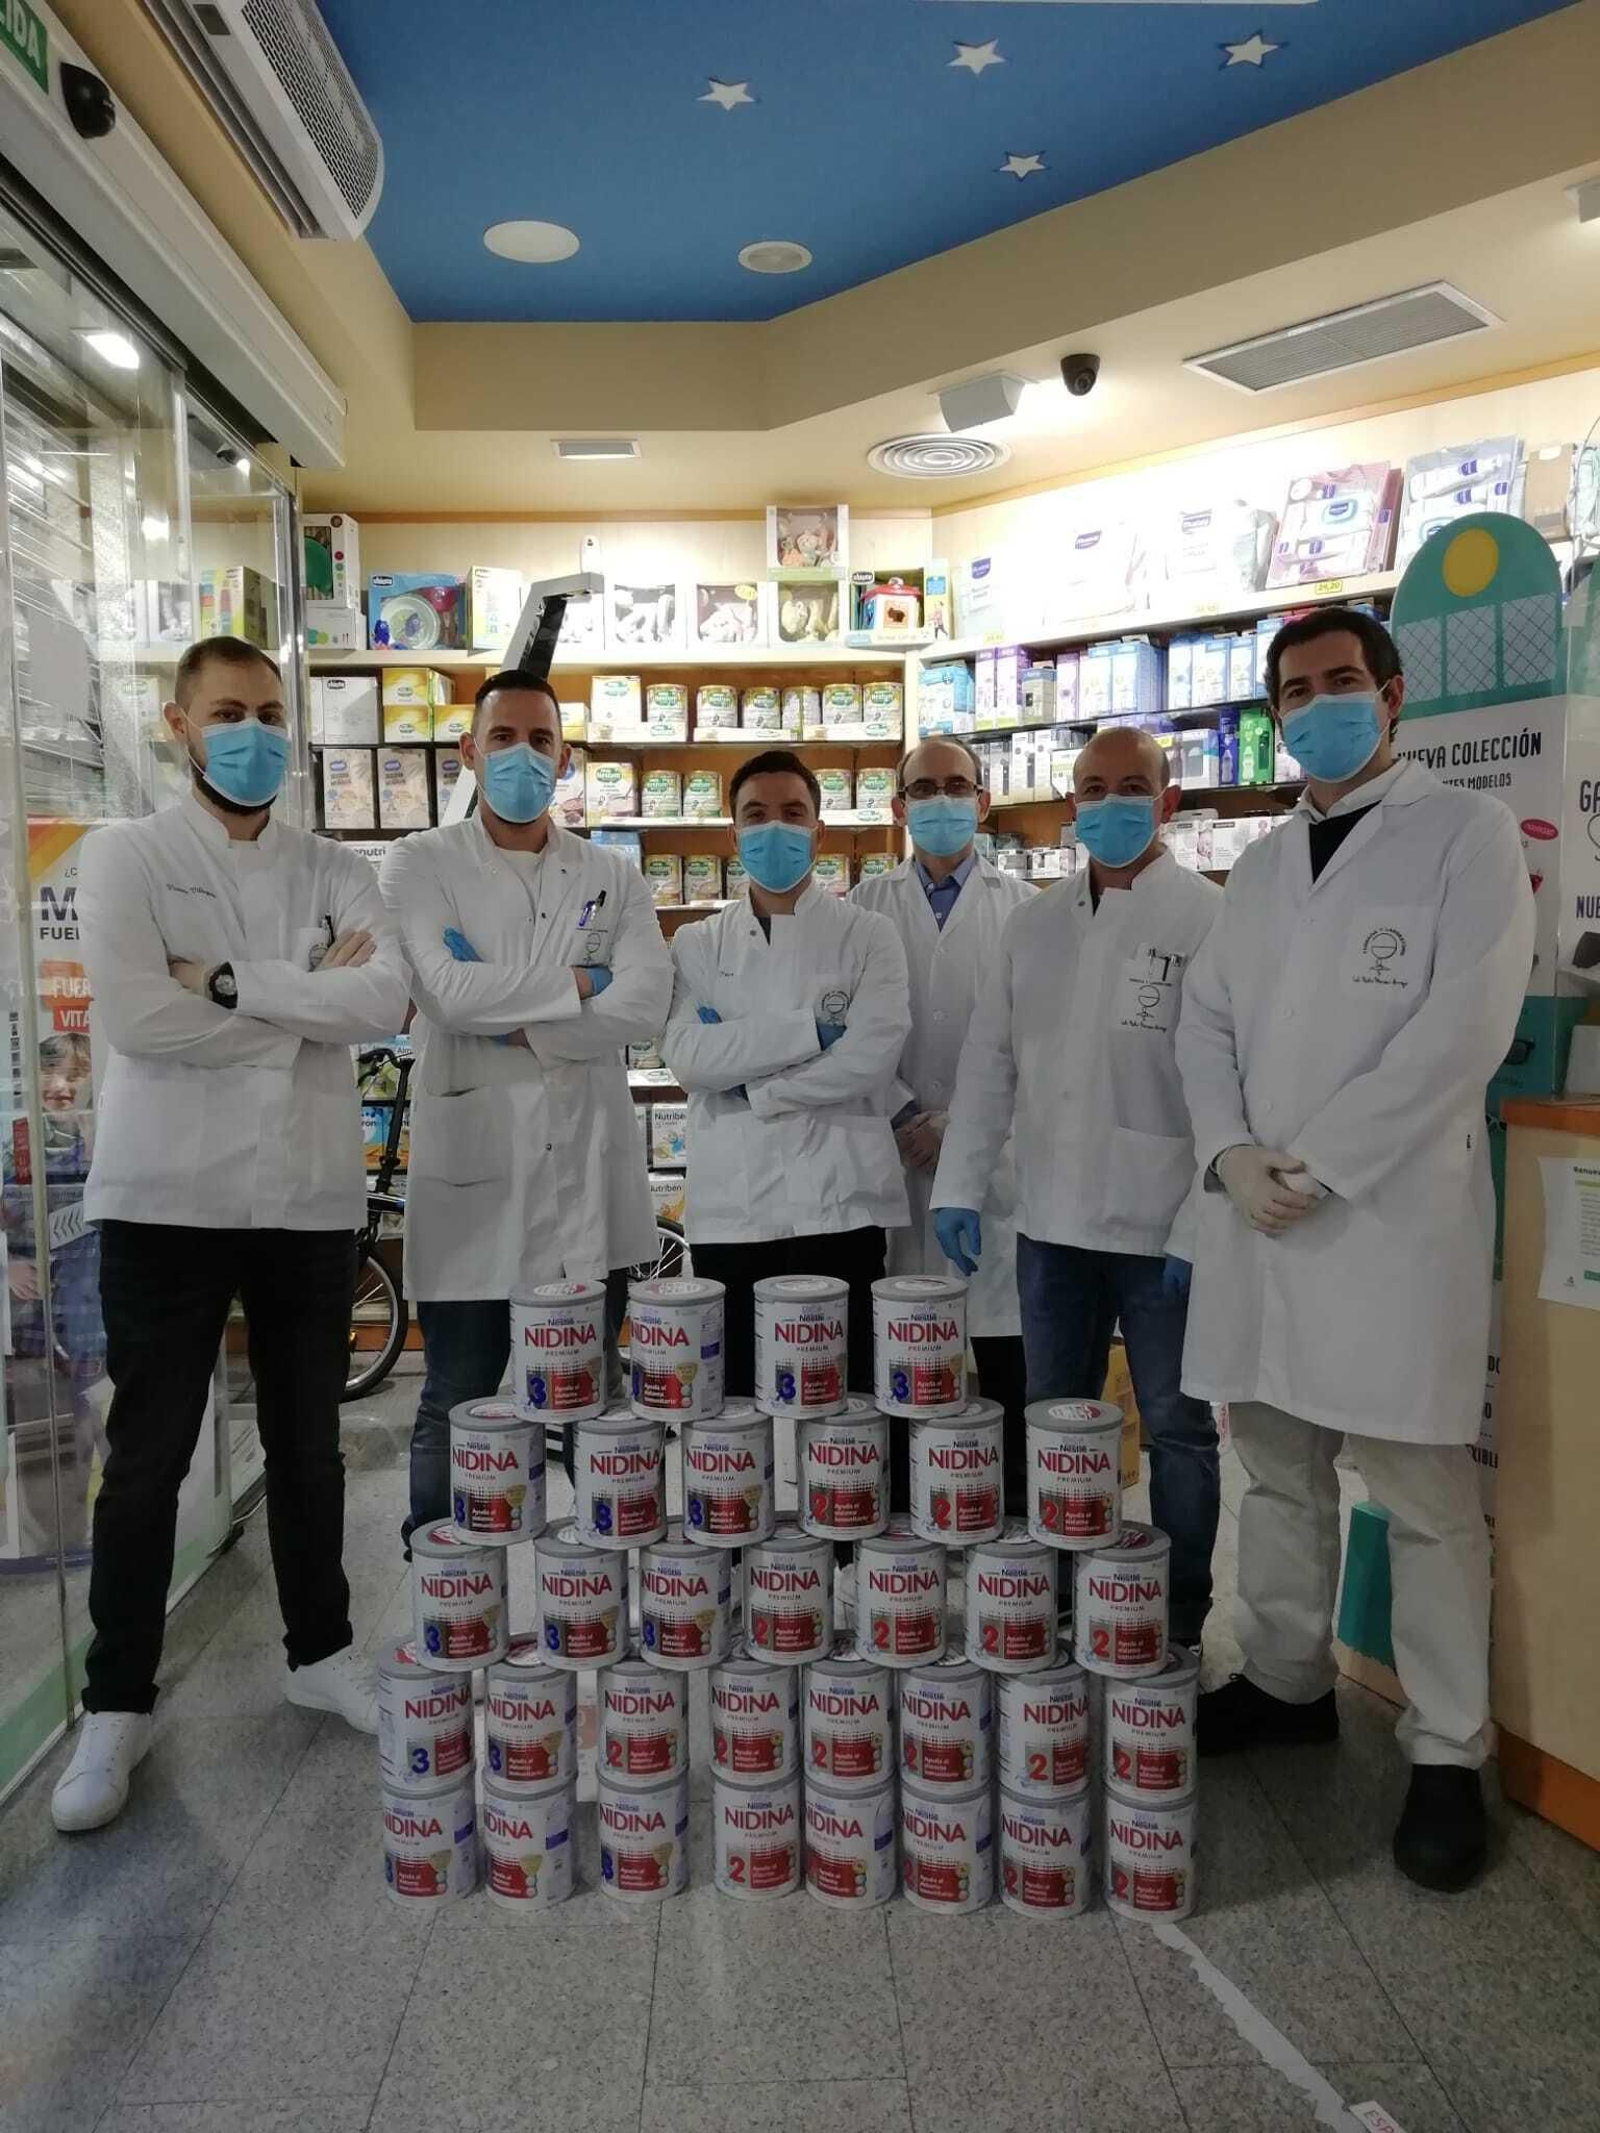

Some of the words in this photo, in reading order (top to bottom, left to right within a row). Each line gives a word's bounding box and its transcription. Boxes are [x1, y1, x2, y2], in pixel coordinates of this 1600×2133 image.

[1452, 728, 1542, 766] COLECCIÓN
[1468, 773, 1512, 790] MODELOS
[525, 1323, 597, 1348] NIDINA
[775, 1321, 843, 1344] NIDINA
[888, 1321, 958, 1342] NIDINA
[529, 1377, 547, 1406] 3
[779, 1372, 797, 1401] 3
[893, 1371, 909, 1402] 3
[452, 1450, 518, 1471] NIDINA
[590, 1449, 661, 1475] NIDINA
[809, 1443, 879, 1465] NIDINA
[928, 1447, 999, 1470] NIDINA
[1038, 1450, 1110, 1474] NIDINA
[596, 1503, 612, 1533] 3
[814, 1494, 830, 1521] 2
[933, 1499, 950, 1529] 2
[1040, 1504, 1058, 1529] 2
[421, 1575, 492, 1598] NIDINA
[542, 1575, 612, 1596] NIDINA
[751, 1567, 820, 1590] NIDINA
[870, 1571, 939, 1593] NIDINA
[978, 1574, 1049, 1598] NIDINA
[1089, 1579, 1161, 1603] NIDINA
[426, 1626, 440, 1652] 3
[545, 1625, 560, 1650] 3
[755, 1616, 769, 1643] 2
[873, 1621, 889, 1649] 2
[983, 1625, 999, 1652] 2
[1092, 1629, 1109, 1657] 2
[405, 1689, 470, 1718] NIDINA
[605, 1692, 675, 1714] NIDINA
[712, 1692, 780, 1713] NIDINA
[810, 1690, 879, 1715] NIDINA
[902, 1695, 971, 1721] NIDINA
[1024, 1696, 1089, 1724] NIDINA
[1112, 1701, 1186, 1727] NIDINA
[412, 1748, 429, 1773] 3
[607, 1741, 623, 1767] 2
[812, 1742, 827, 1768] 2
[1029, 1754, 1048, 1780] 2
[1116, 1754, 1132, 1779] 2
[725, 1805, 793, 1827] NIDINA
[1110, 1824, 1183, 1851] NIDINA
[729, 1856, 746, 1884] 2
[1003, 1867, 1018, 1895] 2
[1112, 1872, 1128, 1899] 2
